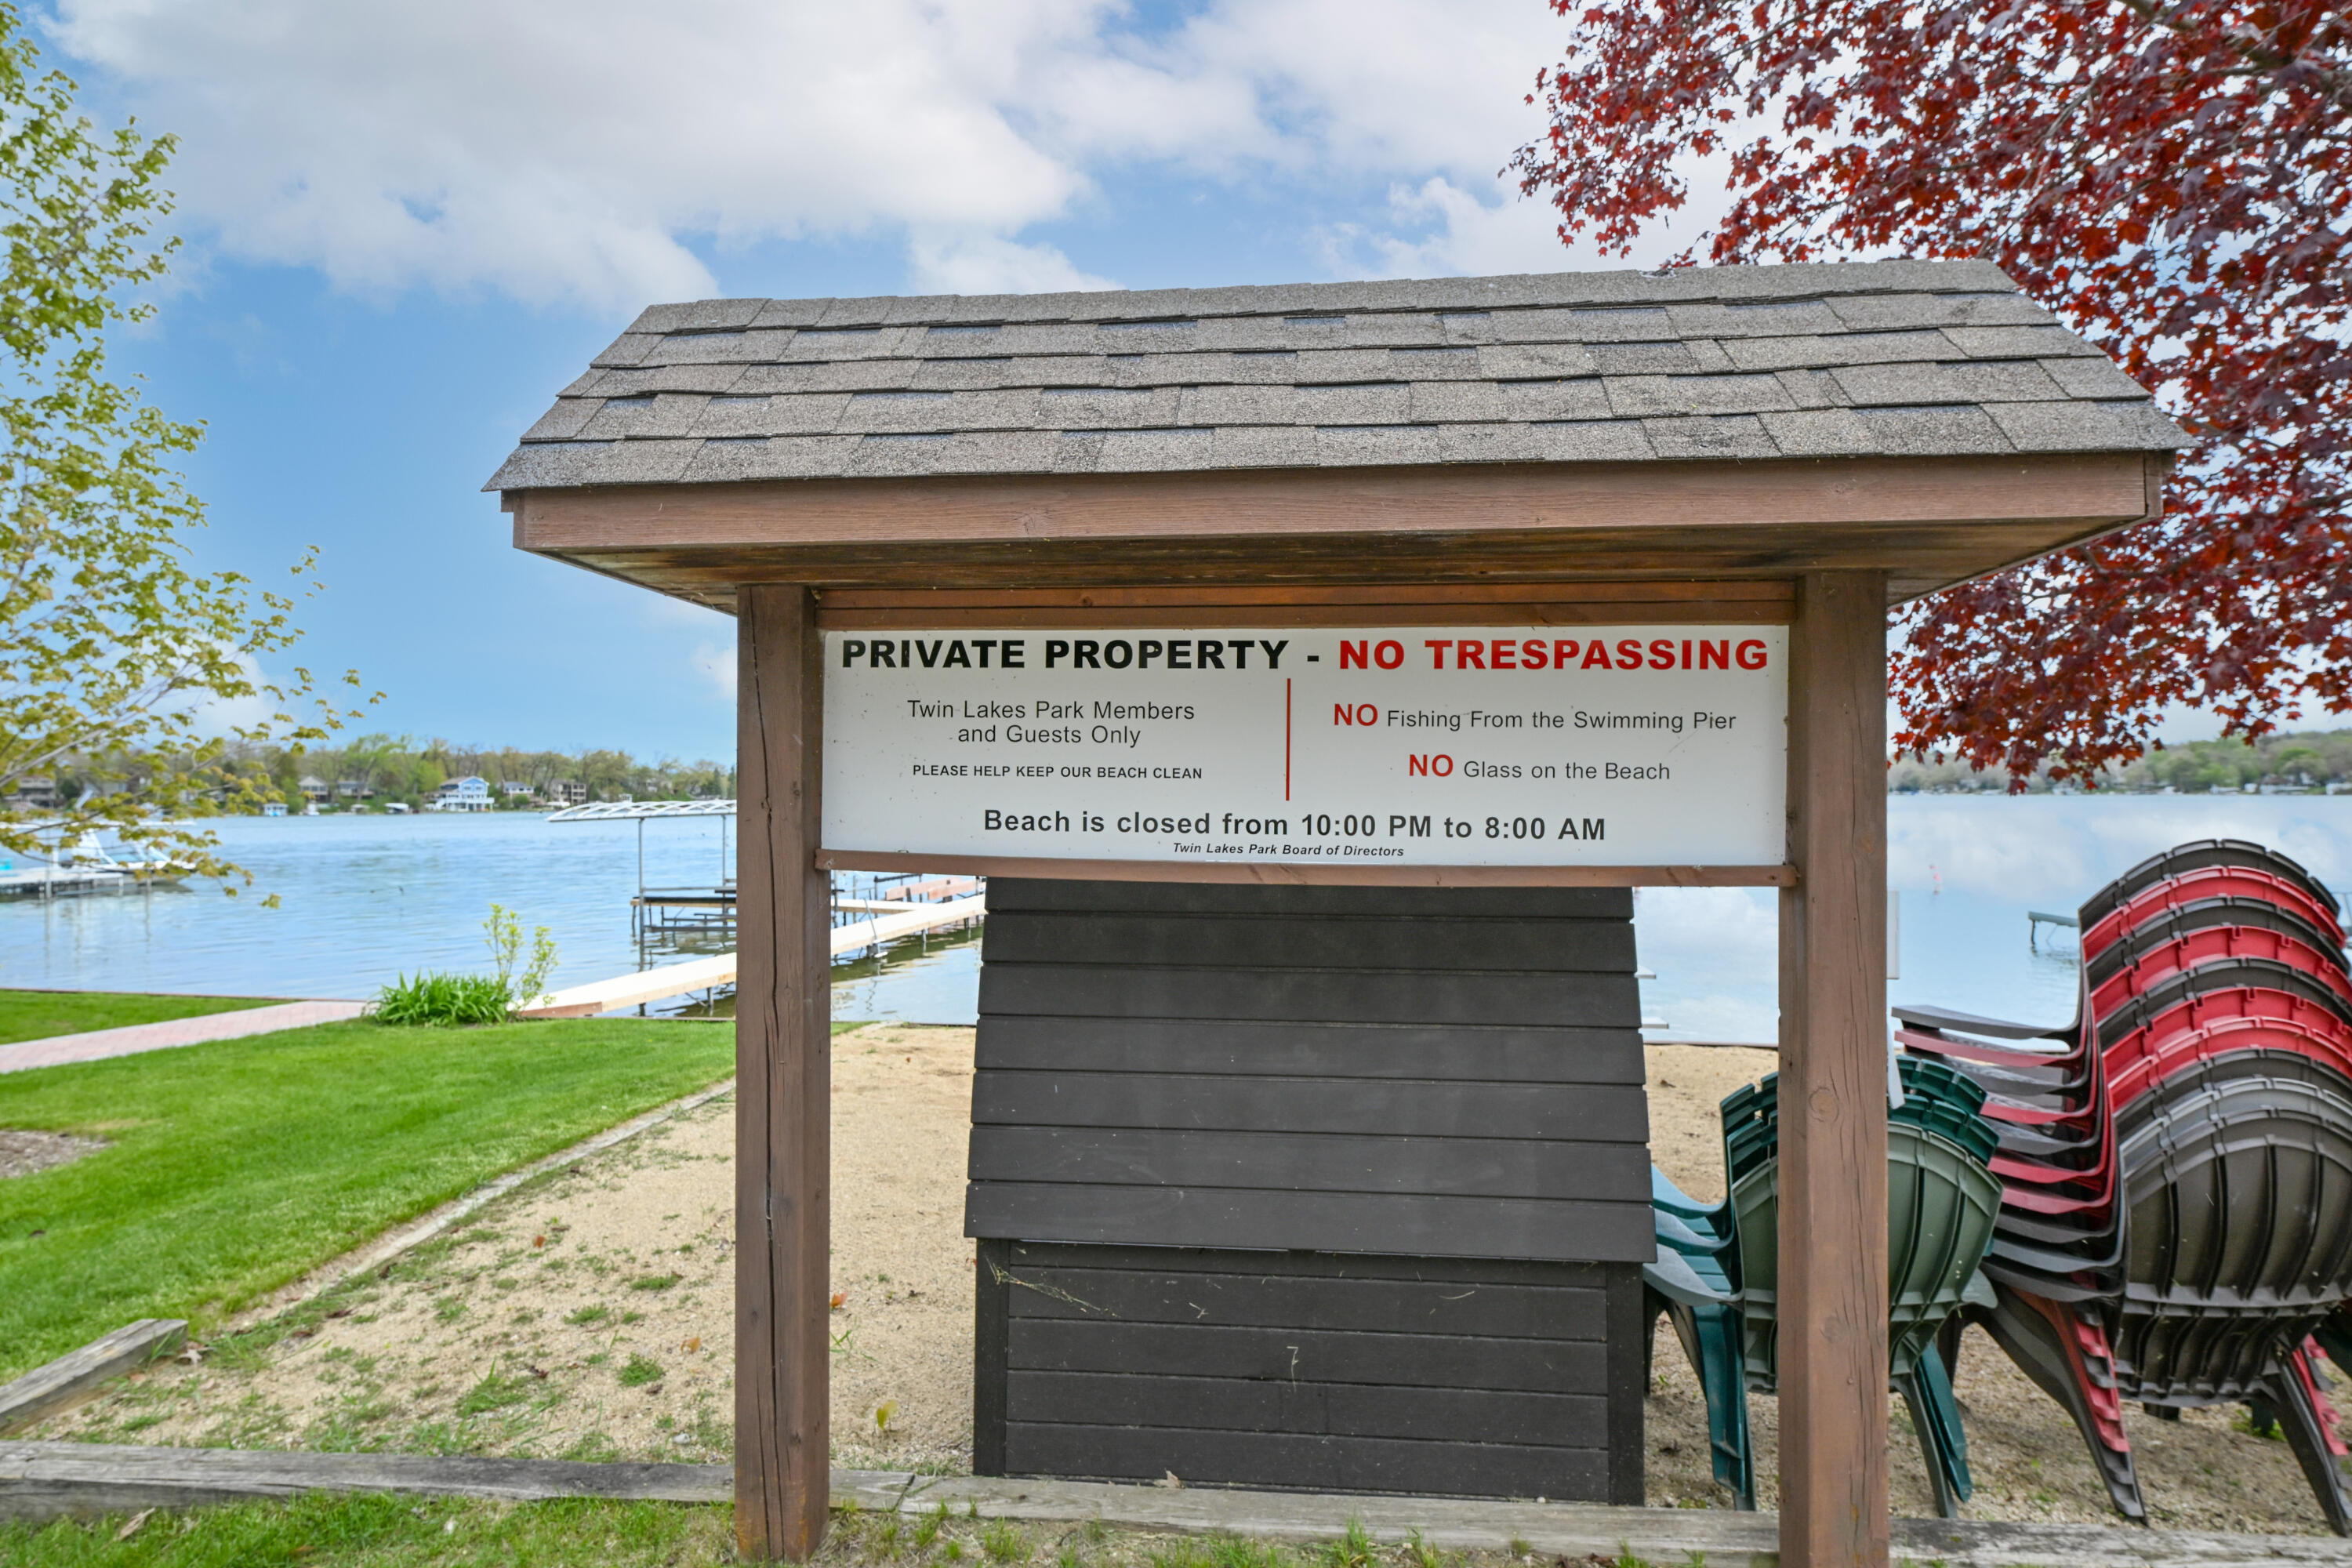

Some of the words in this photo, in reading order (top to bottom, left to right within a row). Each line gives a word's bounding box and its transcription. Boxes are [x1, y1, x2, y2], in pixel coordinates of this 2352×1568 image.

[842, 640, 1025, 669] PRIVATE
[1045, 639, 1289, 670] PROPERTY
[1339, 640, 1405, 670] NO
[1425, 639, 1767, 670] TRESPASSING
[907, 699, 953, 718] Twin
[964, 700, 1025, 719] Lakes
[1036, 700, 1083, 719] Park
[1094, 701, 1195, 720] Members
[1334, 703, 1378, 727] NO
[1388, 710, 1461, 732] Fishing
[1471, 710, 1523, 728] From
[1532, 711, 1564, 728] the
[1573, 710, 1683, 734] Swimming
[1693, 711, 1737, 729] Pier
[958, 724, 996, 742] and
[1006, 724, 1081, 743] Guests
[1091, 724, 1141, 749] Only
[913, 764, 968, 776] PLEASE
[974, 765, 1011, 777] HELP
[1016, 766, 1054, 777] KEEP
[1060, 766, 1091, 778] OUR
[1097, 767, 1147, 779] BEACH
[1152, 767, 1202, 779] CLEAN
[1409, 753, 1454, 777] NO
[1464, 760, 1522, 779] Glass
[1531, 765, 1555, 779] on
[1565, 762, 1597, 779] the
[1605, 762, 1670, 780] Beach
[985, 809, 1069, 832] Beach
[1083, 811, 1105, 833] is
[1117, 811, 1210, 834] closed
[1222, 812, 1287, 835] from
[1301, 814, 1376, 837] 10:00
[1389, 815, 1431, 837] PM
[1443, 817, 1472, 838] to
[1485, 816, 1545, 840] 8:00
[1558, 818, 1605, 840] AM
[1174, 842, 1201, 853] Twin
[1206, 843, 1243, 854] Lakes
[1248, 844, 1277, 855] Park
[1282, 844, 1322, 855] Board
[1326, 845, 1341, 855] of
[1343, 845, 1404, 857] Directors
